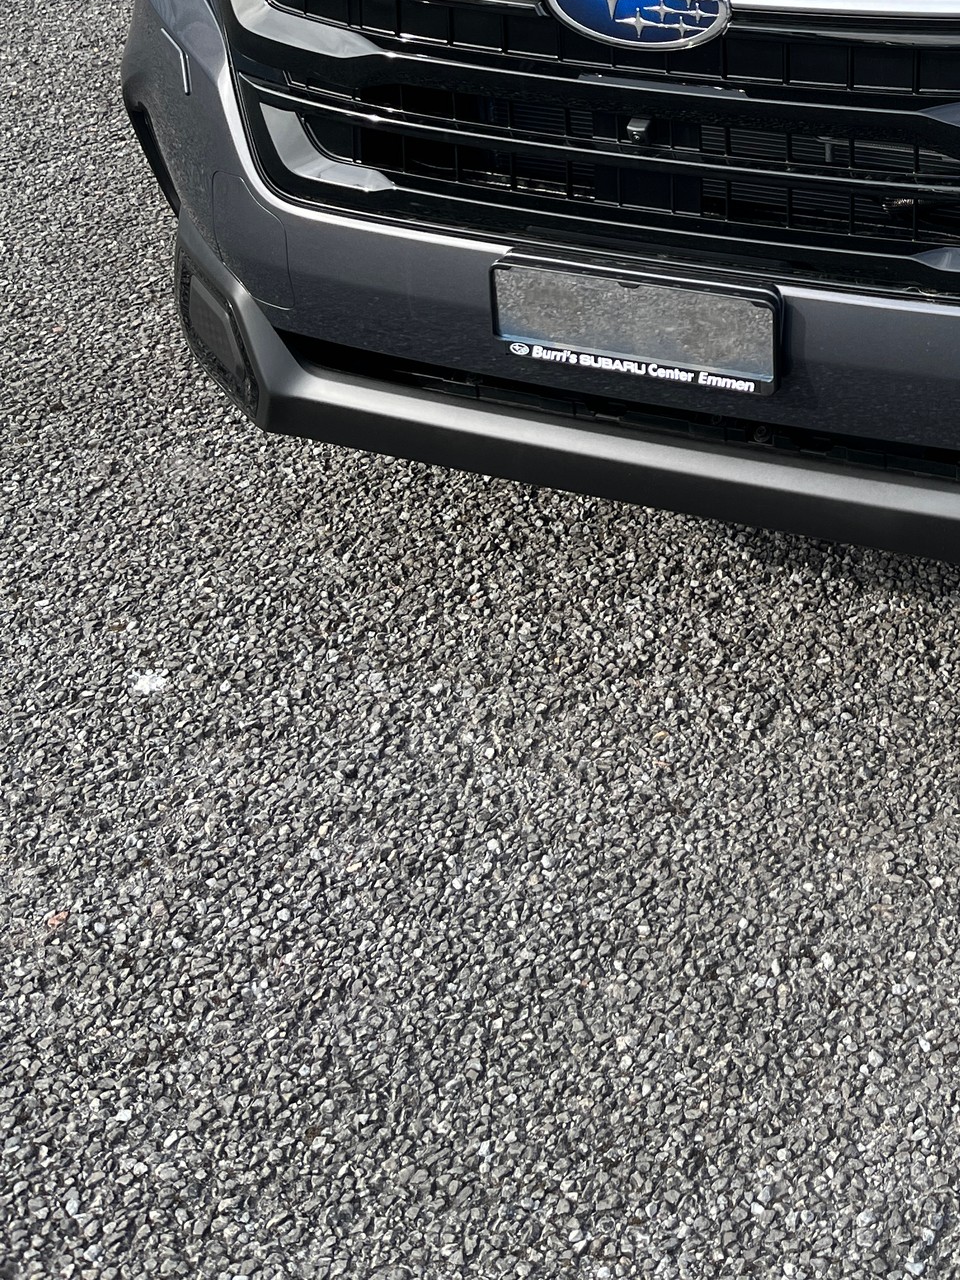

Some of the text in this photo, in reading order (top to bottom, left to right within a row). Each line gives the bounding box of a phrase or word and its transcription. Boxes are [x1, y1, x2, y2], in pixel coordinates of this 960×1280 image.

[531, 345, 755, 392] Burri's SUBARU Center Emmen
